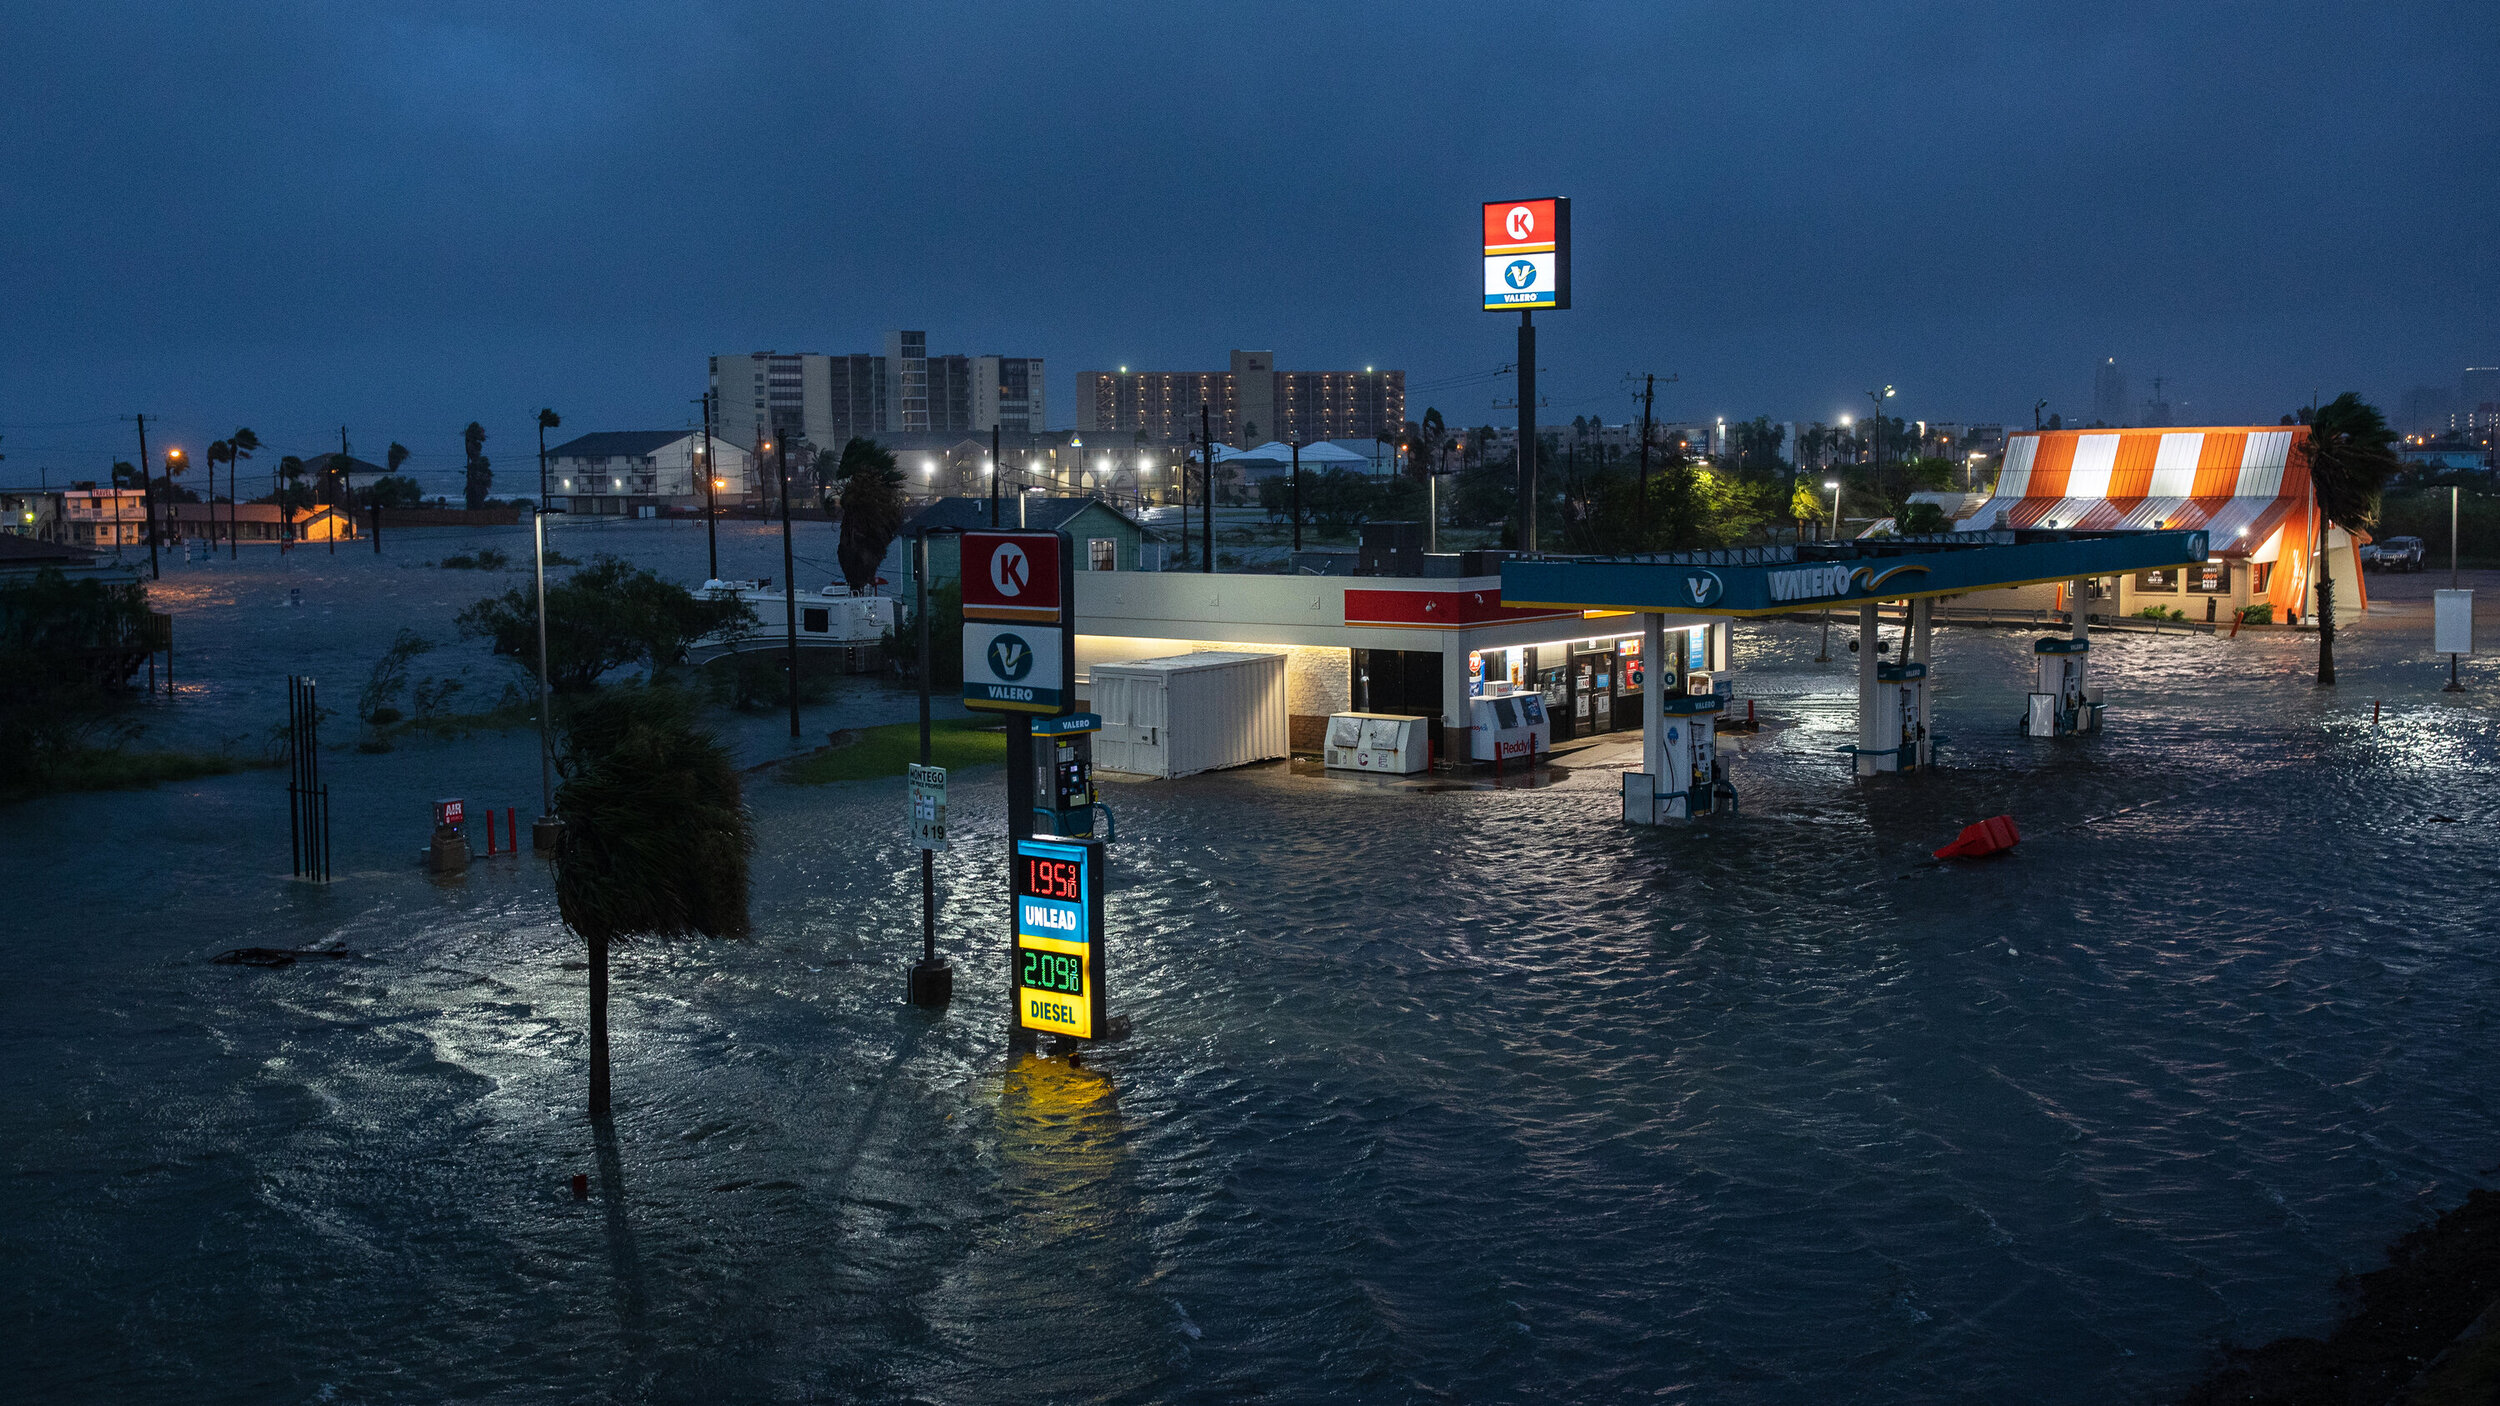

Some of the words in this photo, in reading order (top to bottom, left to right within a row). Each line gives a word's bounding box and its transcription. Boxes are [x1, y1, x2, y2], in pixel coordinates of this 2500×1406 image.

[1504, 293, 1537, 303] VALERO
[93, 489, 111, 497] TRAVEL
[1769, 566, 1850, 600] VALERO
[988, 686, 1033, 701] VALERO
[1062, 719, 1090, 730] VALERO
[445, 803, 462, 816] AIR
[1030, 859, 1067, 897] 1.95
[1025, 905, 1076, 931] UNLEAD
[1024, 952, 1069, 990] 2.09
[1031, 1000, 1076, 1025] DIESEL
